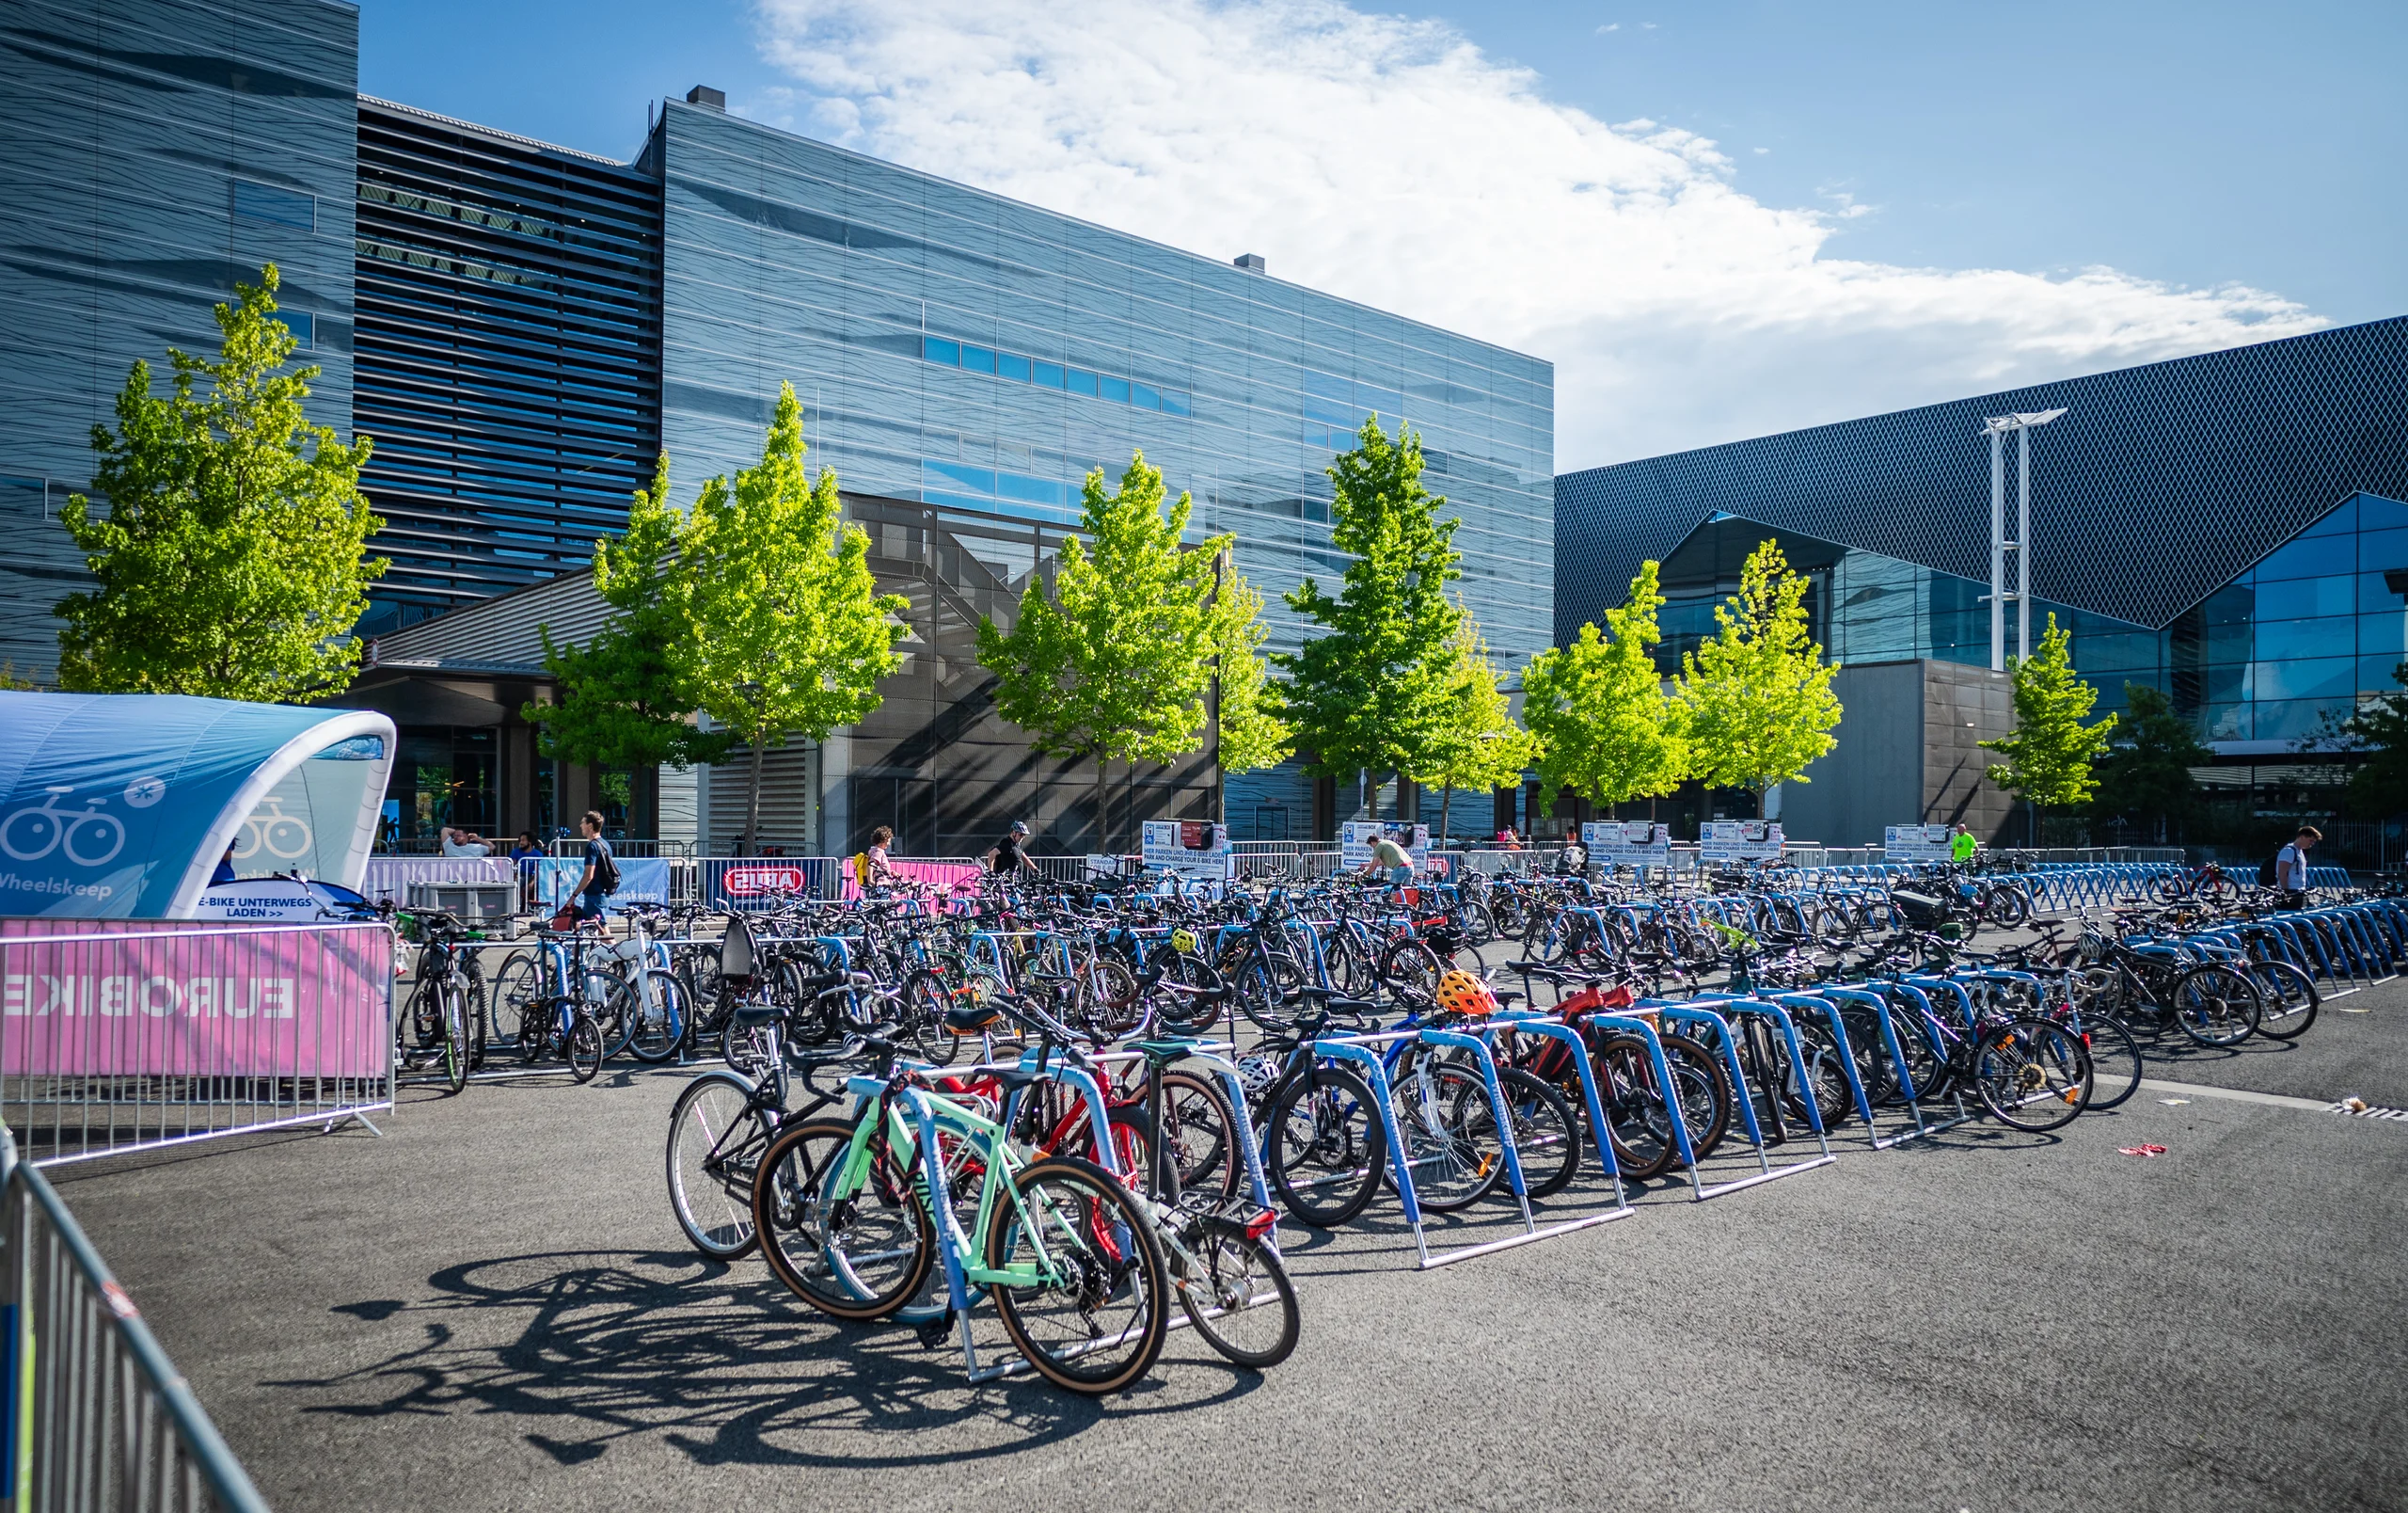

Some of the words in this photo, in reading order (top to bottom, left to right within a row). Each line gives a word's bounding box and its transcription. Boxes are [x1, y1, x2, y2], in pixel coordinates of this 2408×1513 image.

[198, 897, 234, 906] E-BIKE
[239, 898, 311, 907] UNTERWEGS
[227, 908, 266, 917] LADEN
